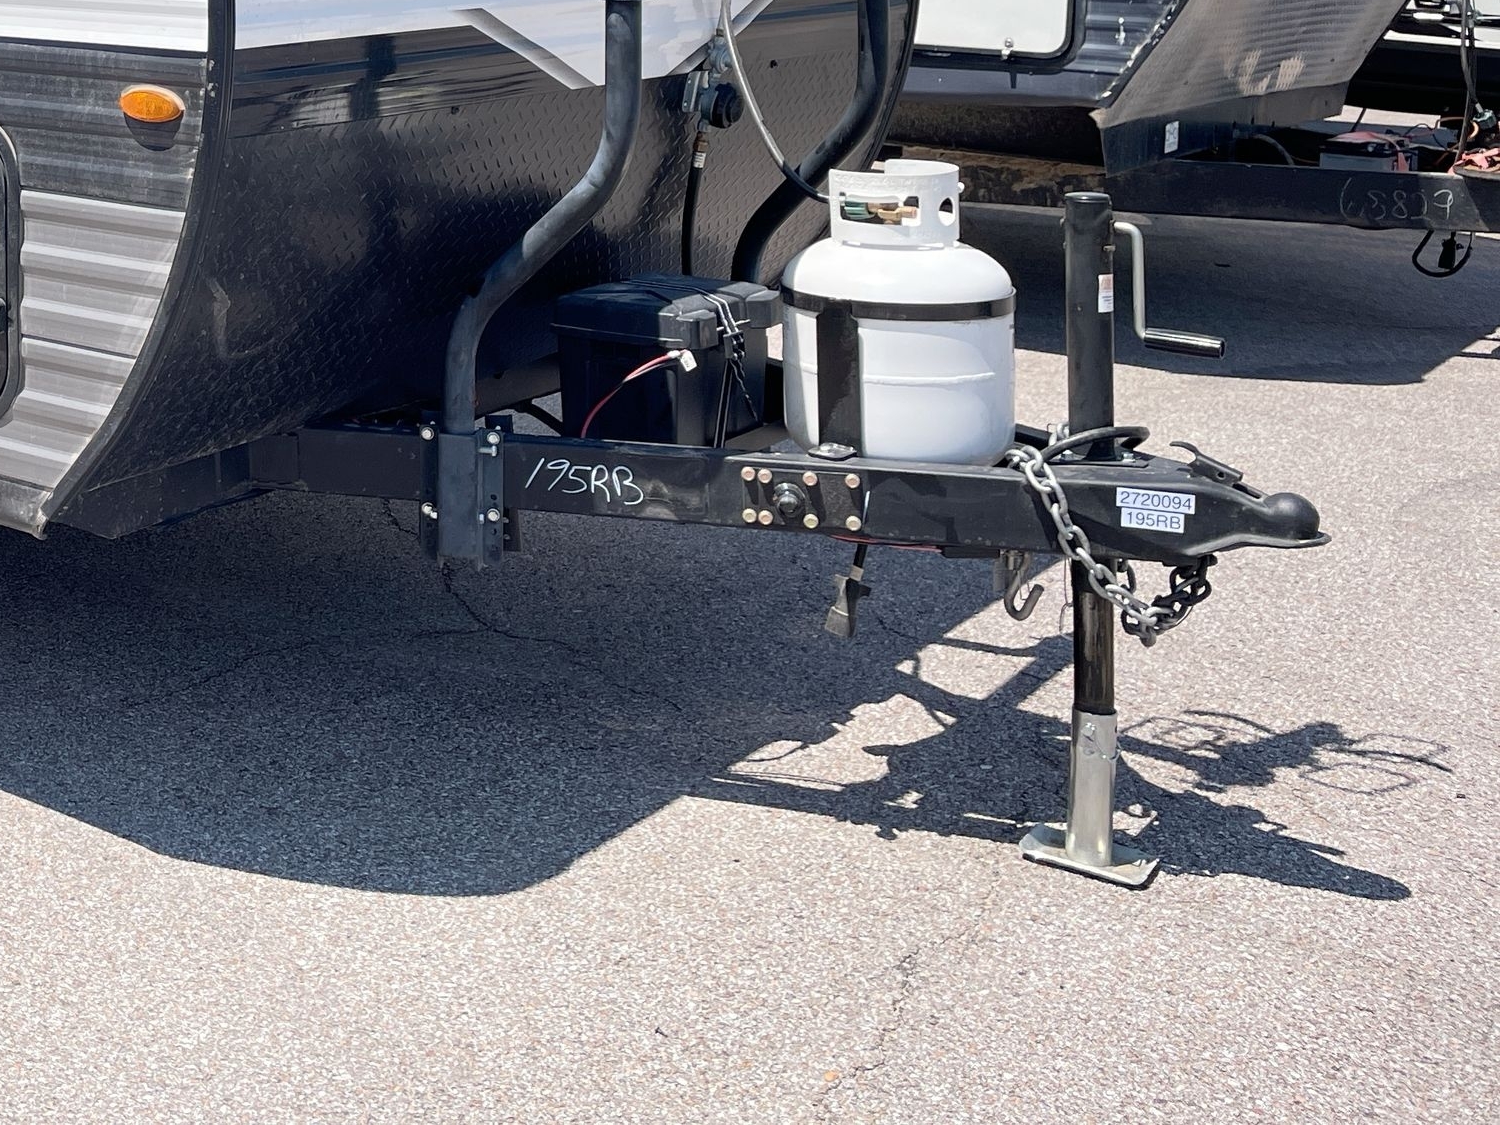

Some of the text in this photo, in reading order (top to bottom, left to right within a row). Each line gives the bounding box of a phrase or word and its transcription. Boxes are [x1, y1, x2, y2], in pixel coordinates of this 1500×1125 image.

[525, 458, 644, 505] 195RB
[1120, 491, 1192, 511] 2720094
[1127, 511, 1181, 530] 195RB
